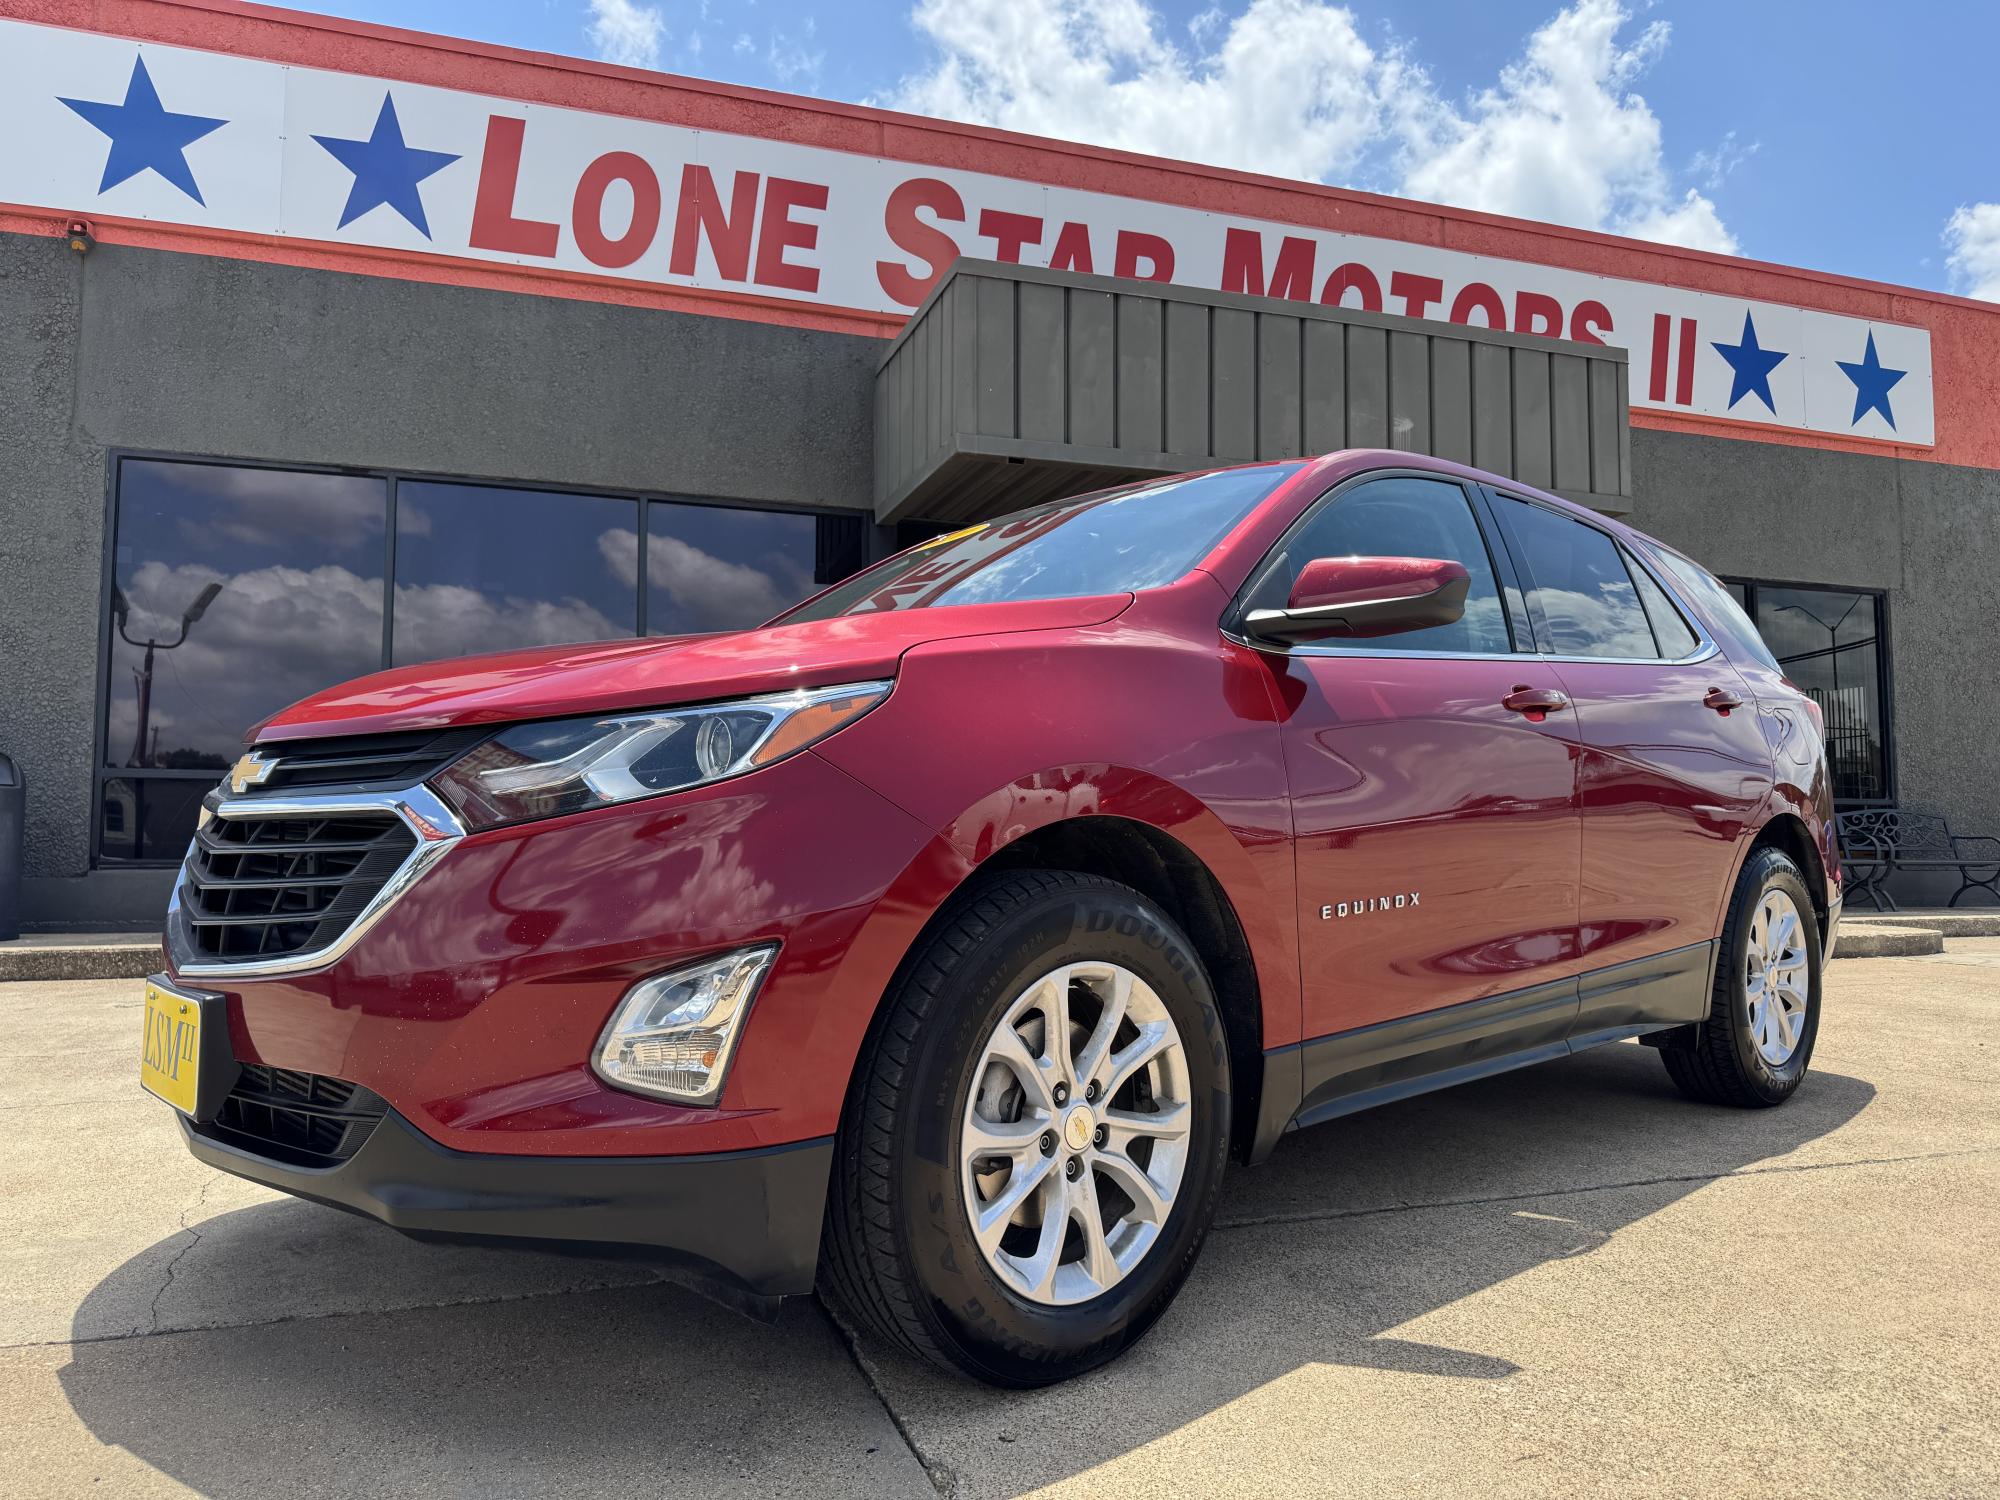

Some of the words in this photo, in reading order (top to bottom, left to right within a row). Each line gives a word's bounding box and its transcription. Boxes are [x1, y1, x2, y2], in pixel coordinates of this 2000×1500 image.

[469, 115, 829, 293] LONE
[1649, 313, 1698, 405] II
[1320, 892, 1420, 919] EQUINOX
[1086, 909, 1225, 1068] DOUGLAS
